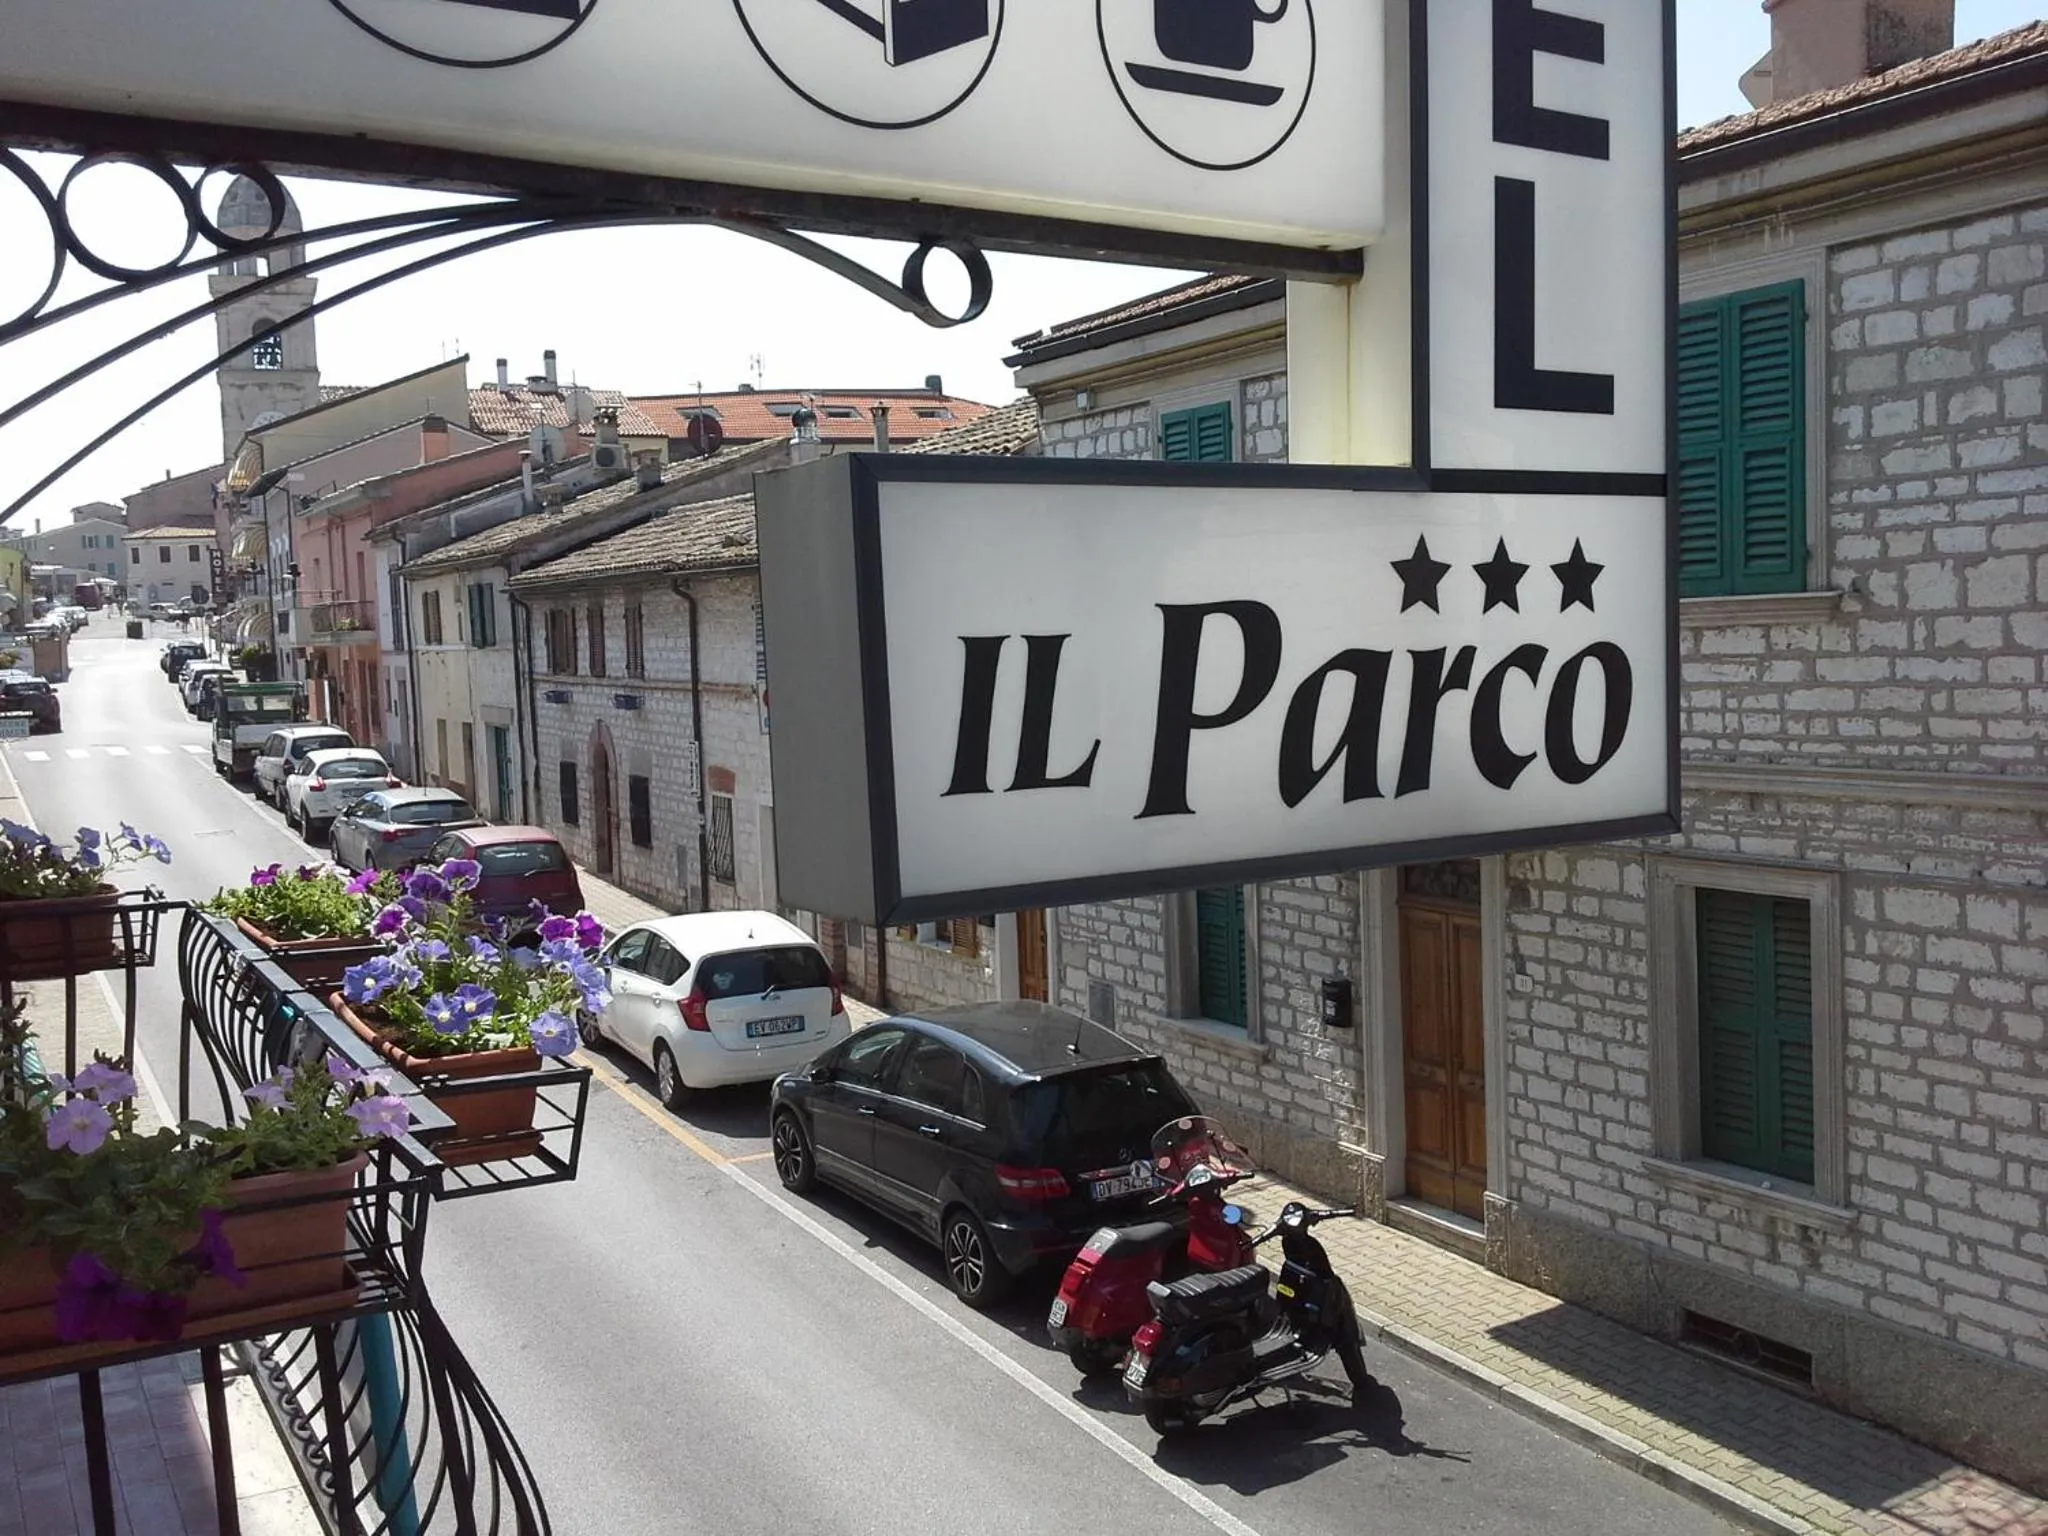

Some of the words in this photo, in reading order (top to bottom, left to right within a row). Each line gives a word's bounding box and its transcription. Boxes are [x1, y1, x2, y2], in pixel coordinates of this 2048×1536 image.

[212, 551, 223, 592] HOTEL
[940, 634, 1101, 798] IL
[1134, 600, 1633, 820] Parco
[1098, 1181, 1112, 1197] DV
